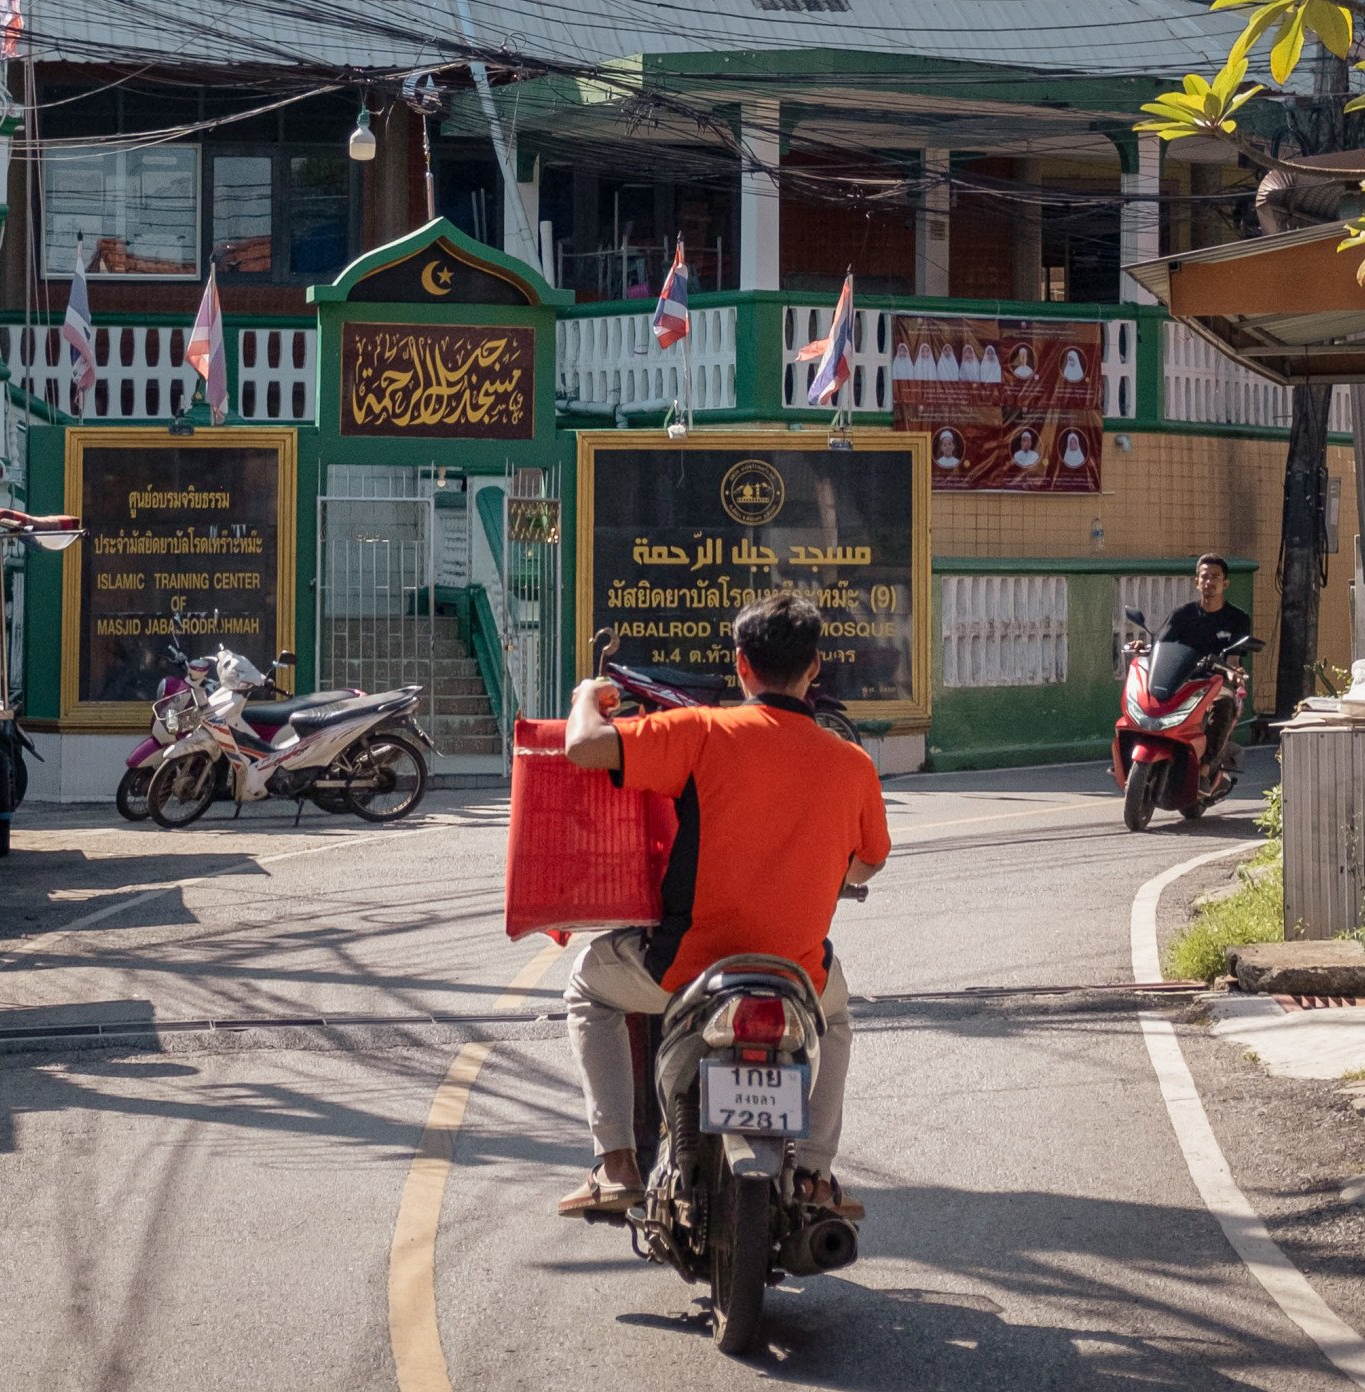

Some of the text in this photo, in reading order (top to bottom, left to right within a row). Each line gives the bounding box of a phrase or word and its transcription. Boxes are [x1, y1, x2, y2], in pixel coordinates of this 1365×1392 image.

[128, 484, 230, 519] ศูนย์อบรมจริยธรรม
[731, 537, 779, 573] جبل
[789, 544, 872, 573] مسجد
[97, 572, 261, 590] ISLAMIC TRAINING CENTER
[170, 596, 187, 613] OF
[870, 584, 898, 613] (9)
[97, 617, 260, 636] MASJID JABARODRHMAH
[719, 1109, 788, 1130] 7281
